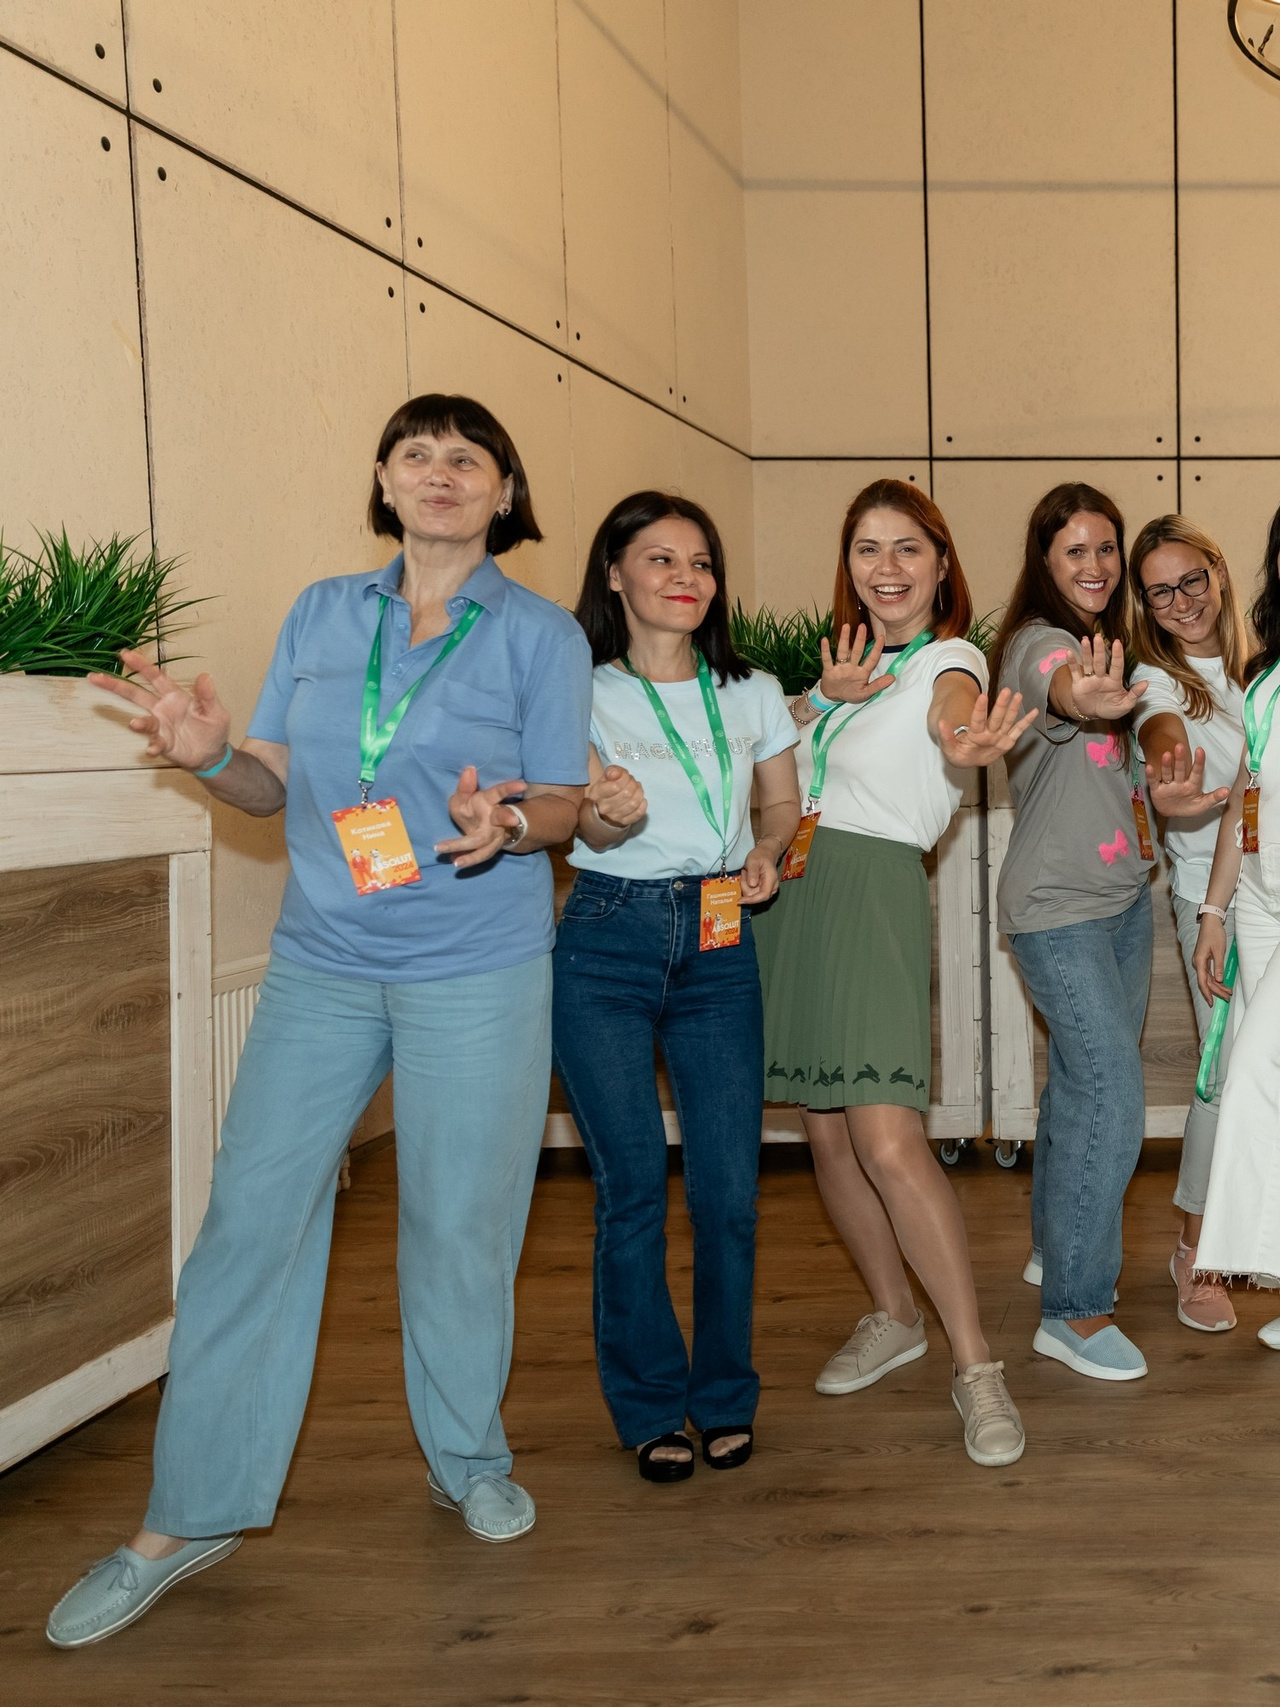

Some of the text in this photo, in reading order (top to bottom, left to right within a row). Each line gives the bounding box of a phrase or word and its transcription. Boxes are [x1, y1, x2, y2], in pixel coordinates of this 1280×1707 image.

[371, 852, 412, 874] ABSOLUT
[393, 860, 414, 873] 2024
[712, 920, 739, 934] ABSOLUT
